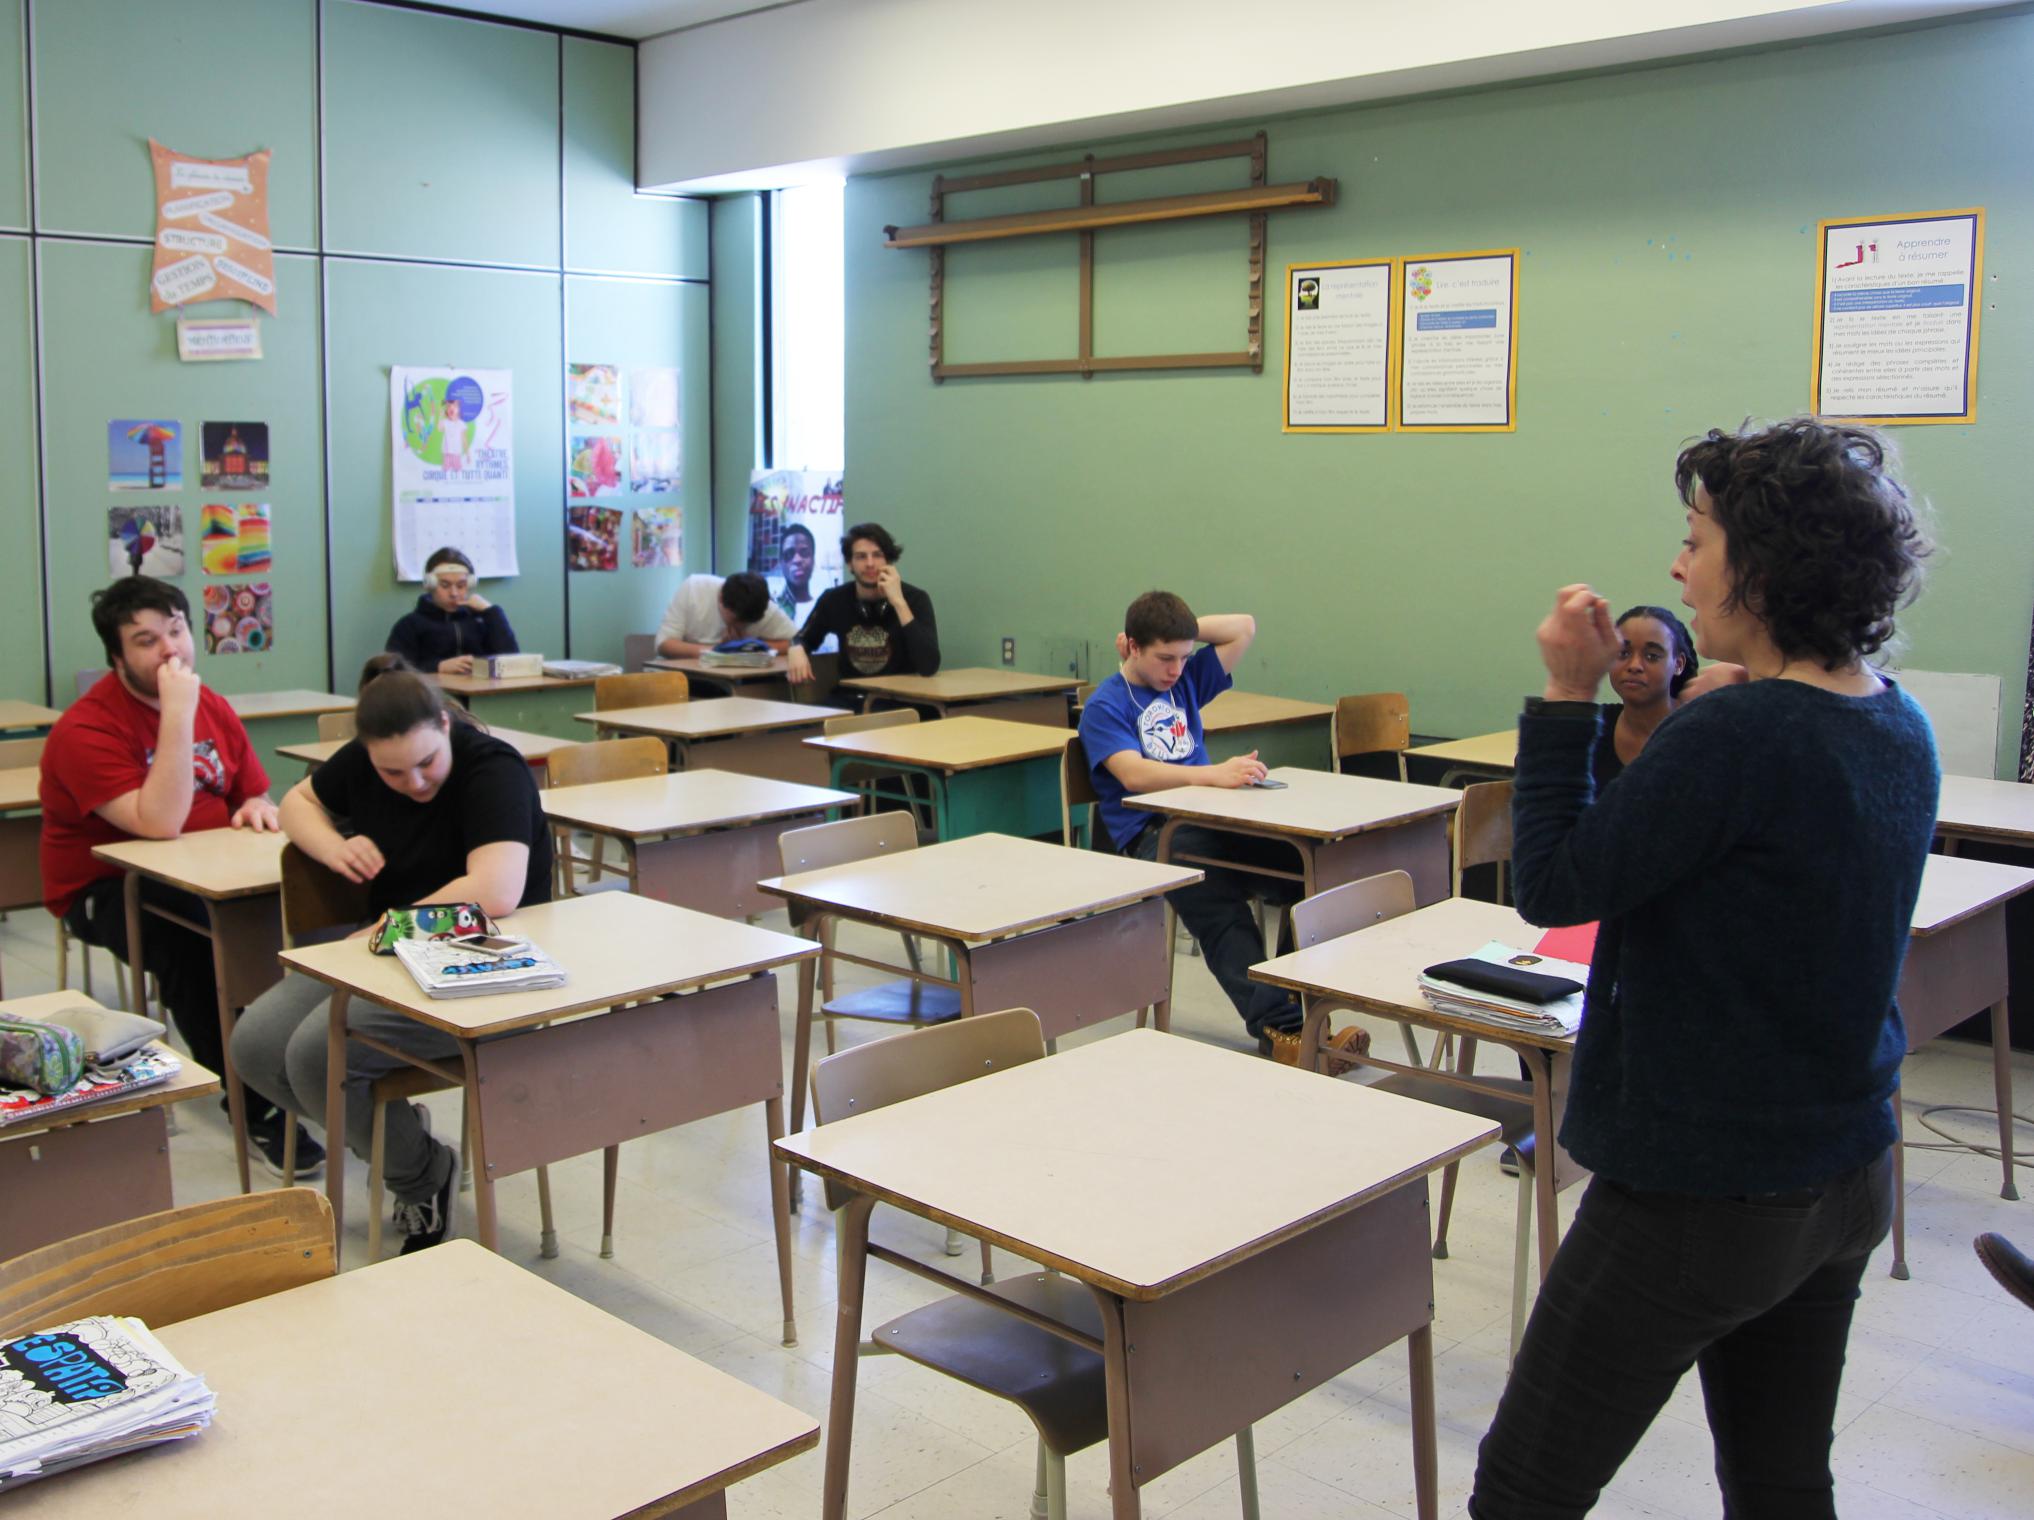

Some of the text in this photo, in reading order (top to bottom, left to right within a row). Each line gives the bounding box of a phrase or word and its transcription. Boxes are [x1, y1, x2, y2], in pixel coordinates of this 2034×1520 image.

[163, 233, 223, 250] STRUCTURE
[1897, 237, 1951, 249] Apprendre
[1908, 251, 1947, 261] résumer
